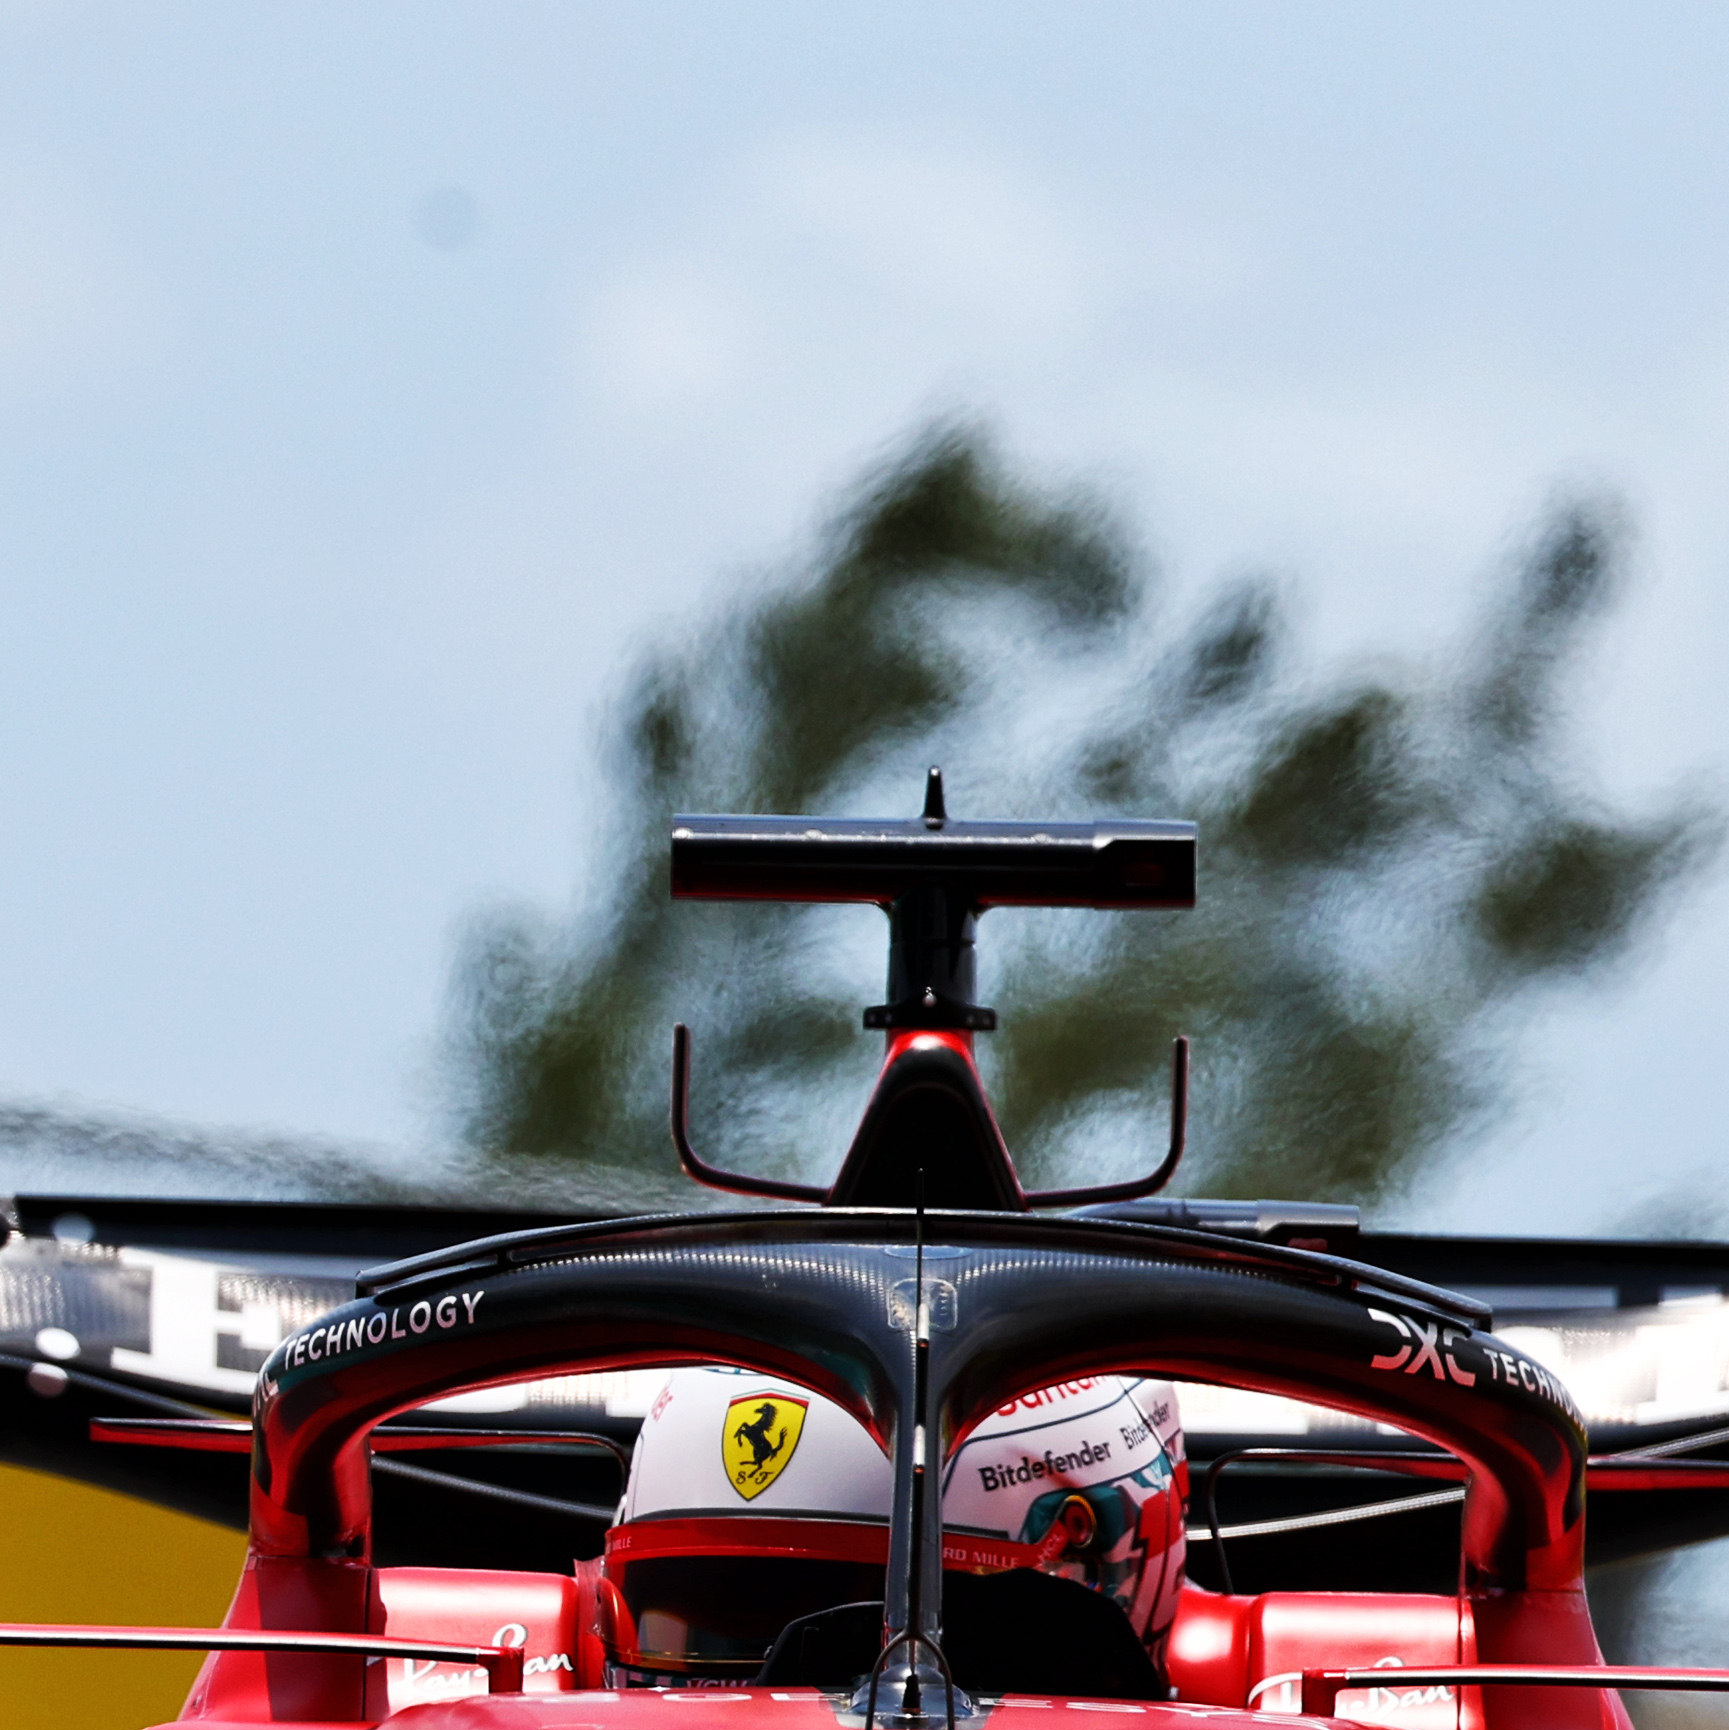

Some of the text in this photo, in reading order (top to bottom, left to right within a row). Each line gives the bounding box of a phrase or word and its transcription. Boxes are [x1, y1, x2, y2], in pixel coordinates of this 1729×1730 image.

[284, 1290, 484, 1371] TECHNOLOGY
[1368, 1307, 1476, 1388] DXC
[978, 1440, 1112, 1493] Bitdefender
